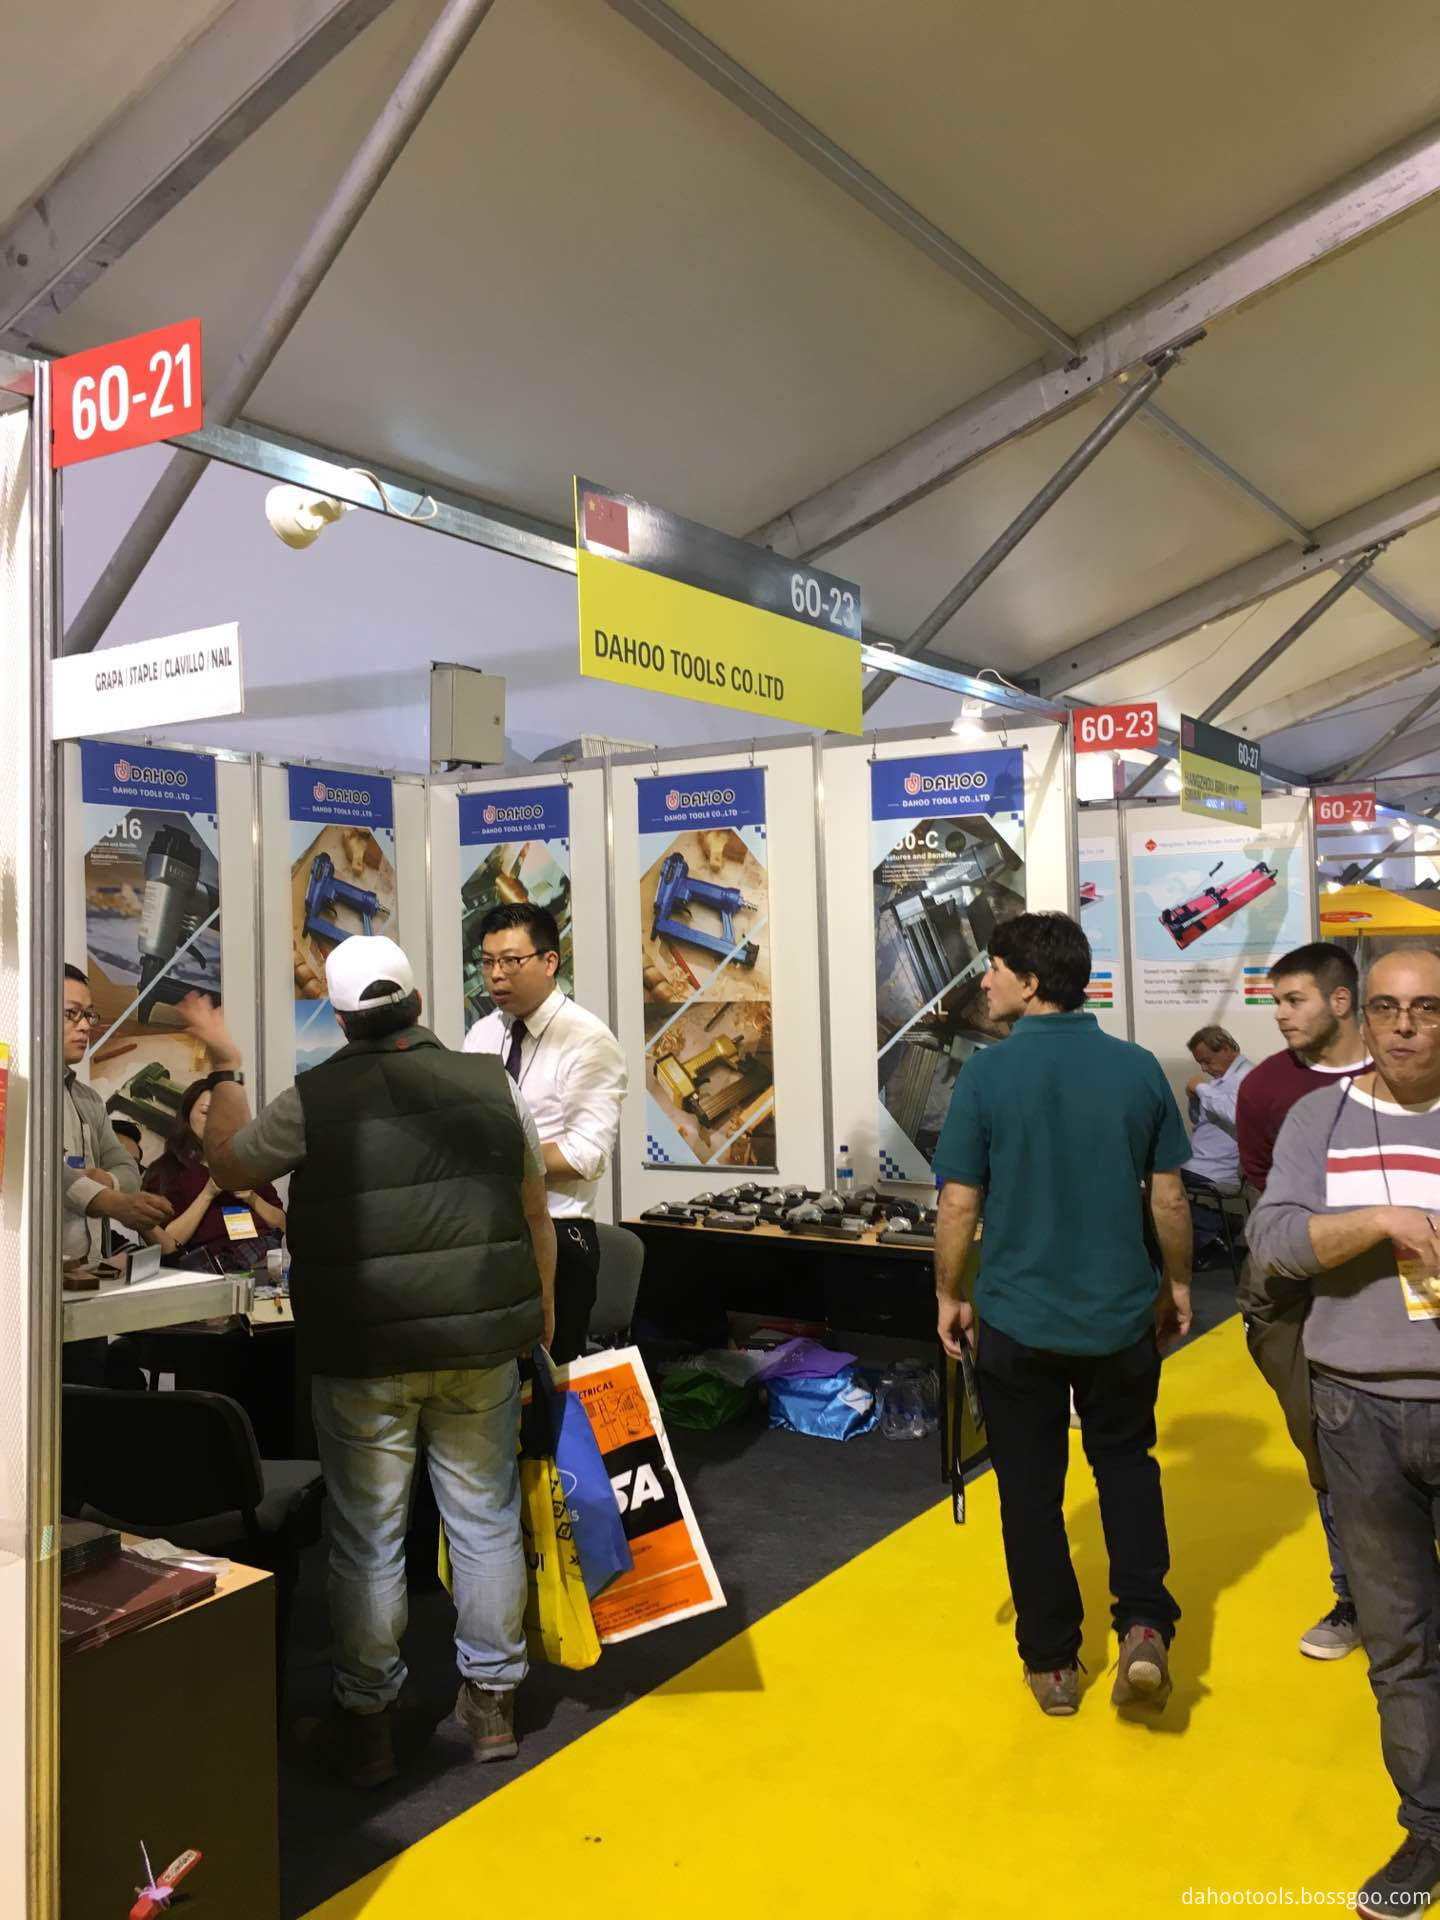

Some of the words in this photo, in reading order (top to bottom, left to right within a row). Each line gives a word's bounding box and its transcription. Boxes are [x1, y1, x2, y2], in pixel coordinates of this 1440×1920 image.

[71, 343, 193, 441] 60-21
[791, 573, 855, 628] 60-23
[95, 669, 123, 692] GRAPA
[130, 662, 158, 685] STAPLE
[165, 651, 205, 678] CLAVILLO
[211, 646, 232, 668] NAIL
[594, 630, 665, 672] DAHOO
[670, 649, 726, 687] TOOLS
[731, 666, 784, 701] CO.LTD
[1081, 710, 1154, 742] 60-23
[1238, 742, 1260, 770] 60-27
[131, 765, 188, 787] DAHOO
[922, 771, 988, 792] DAHOO
[326, 787, 371, 805] DAHOO
[680, 788, 736, 808] DAHOO
[496, 804, 544, 822] DAHOO
[1320, 800, 1374, 820] 60-27
[578, 1381, 614, 1400] CTRICAS
[609, 1463, 665, 1515] SA
